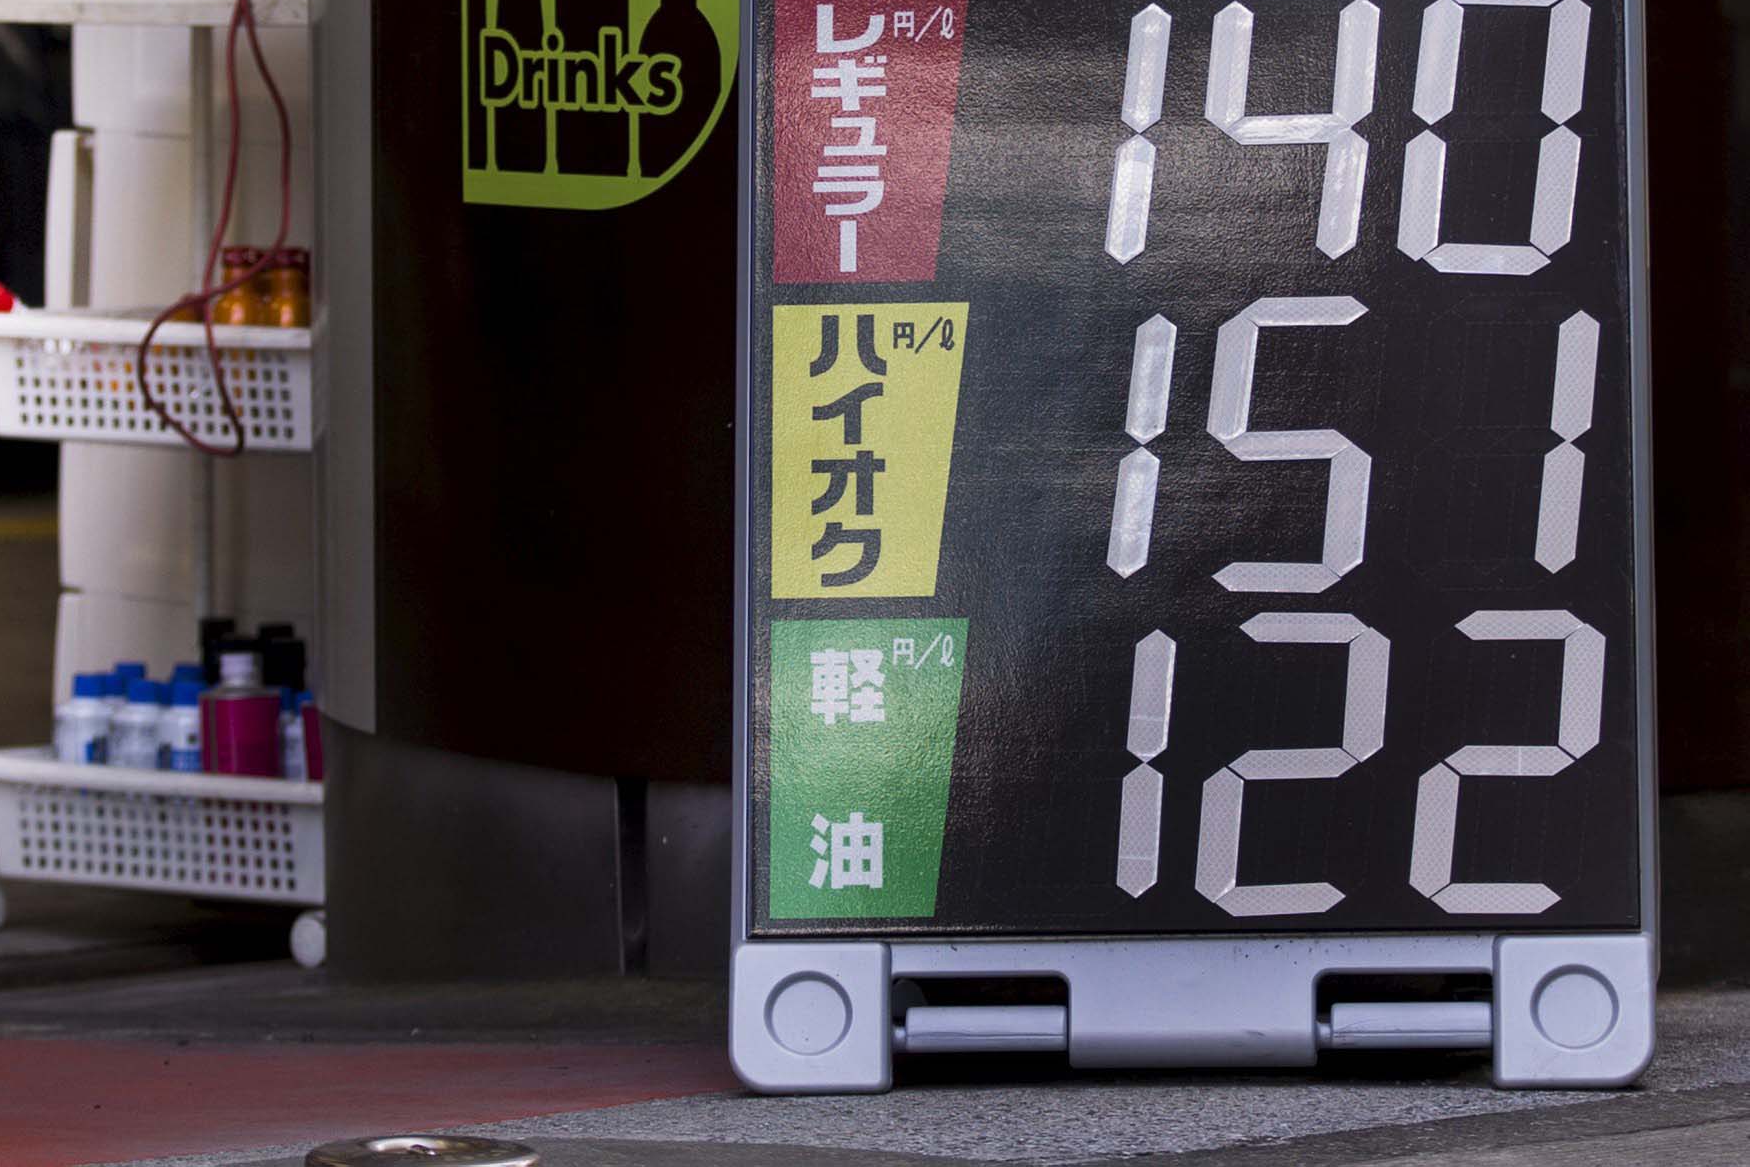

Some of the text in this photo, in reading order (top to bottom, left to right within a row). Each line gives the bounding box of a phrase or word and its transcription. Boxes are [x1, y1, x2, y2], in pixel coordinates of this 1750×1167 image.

[483, 31, 679, 109] Drinks
[811, 4, 887, 273] レギュラー
[809, 314, 887, 587] ハイオク
[1106, 295, 1601, 593] 151
[808, 648, 886, 890] 軽油
[1116, 610, 1606, 917] 122
